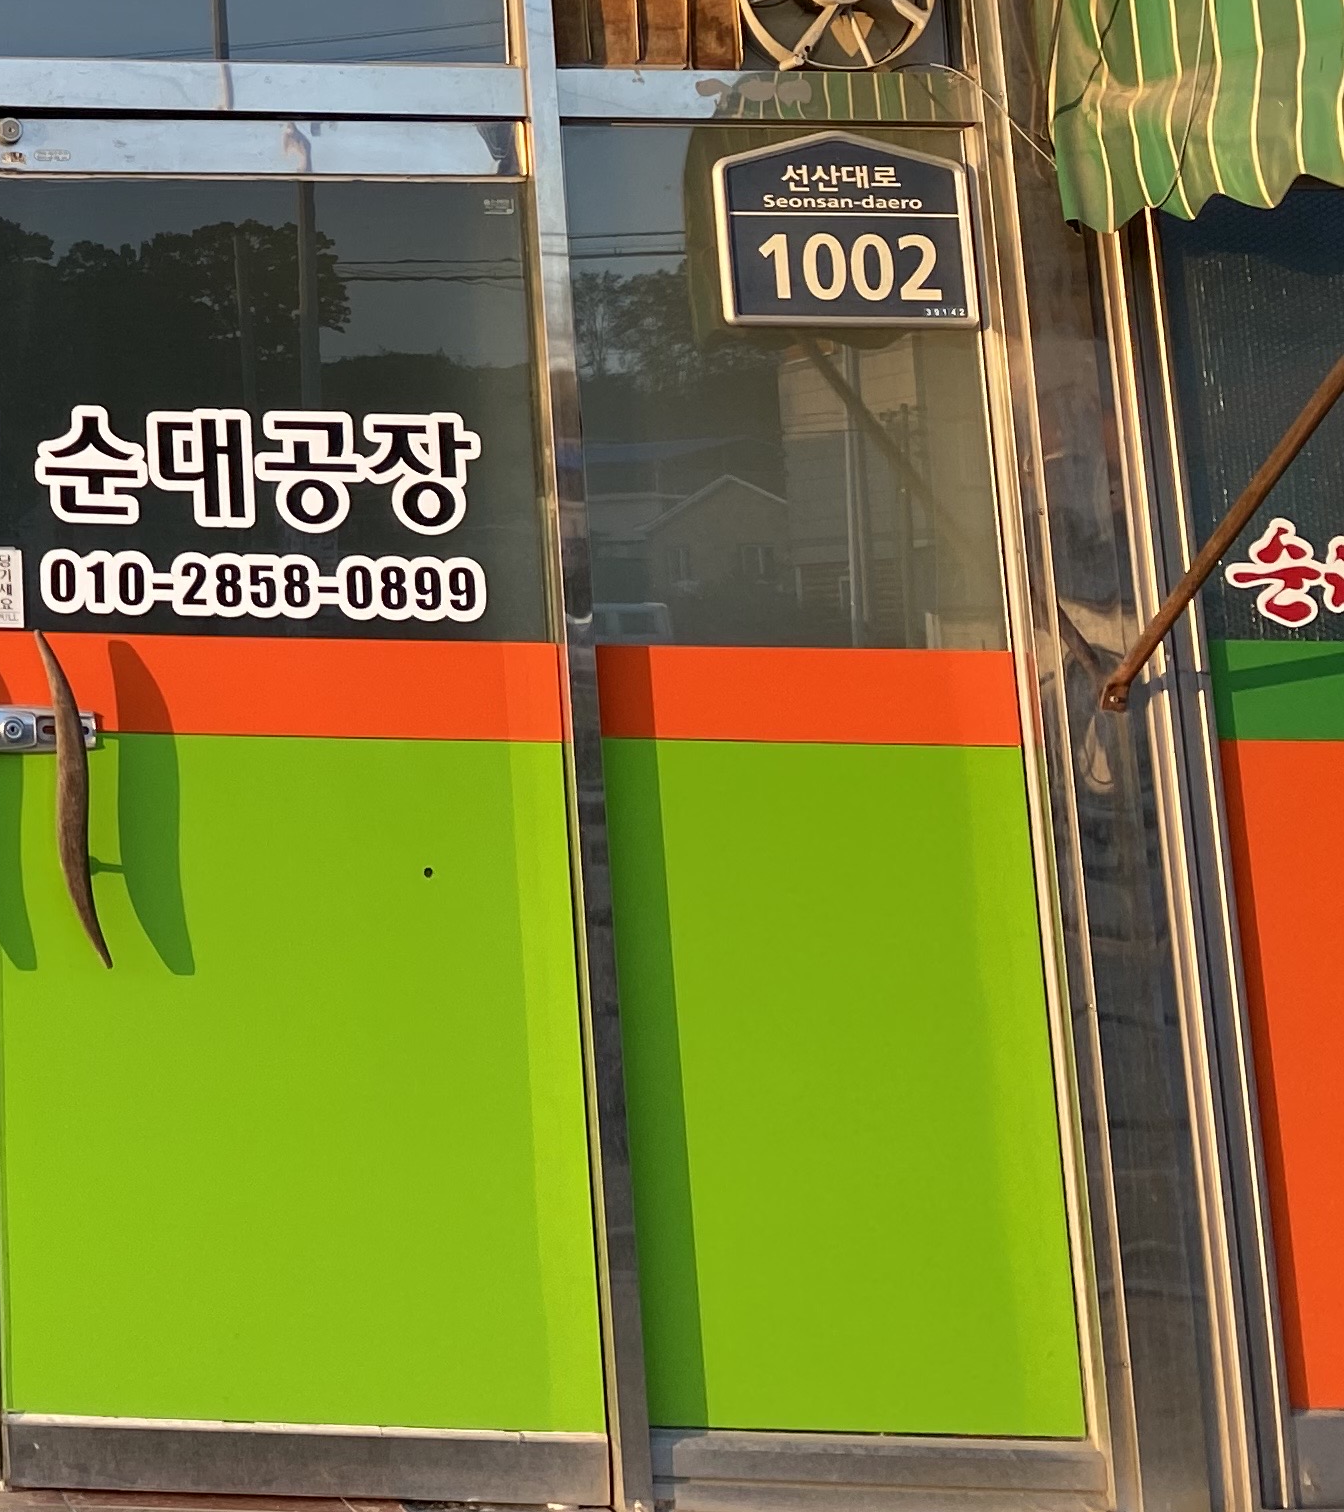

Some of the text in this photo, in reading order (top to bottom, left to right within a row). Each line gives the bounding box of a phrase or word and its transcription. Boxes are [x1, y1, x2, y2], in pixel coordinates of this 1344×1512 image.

[762, 194, 923, 210] Seonsan-daero
[780, 164, 902, 192] 선산대로
[757, 232, 943, 302] 1002
[43, 414, 473, 527] 순대공장
[49, 558, 477, 613] 010-2858-0899
